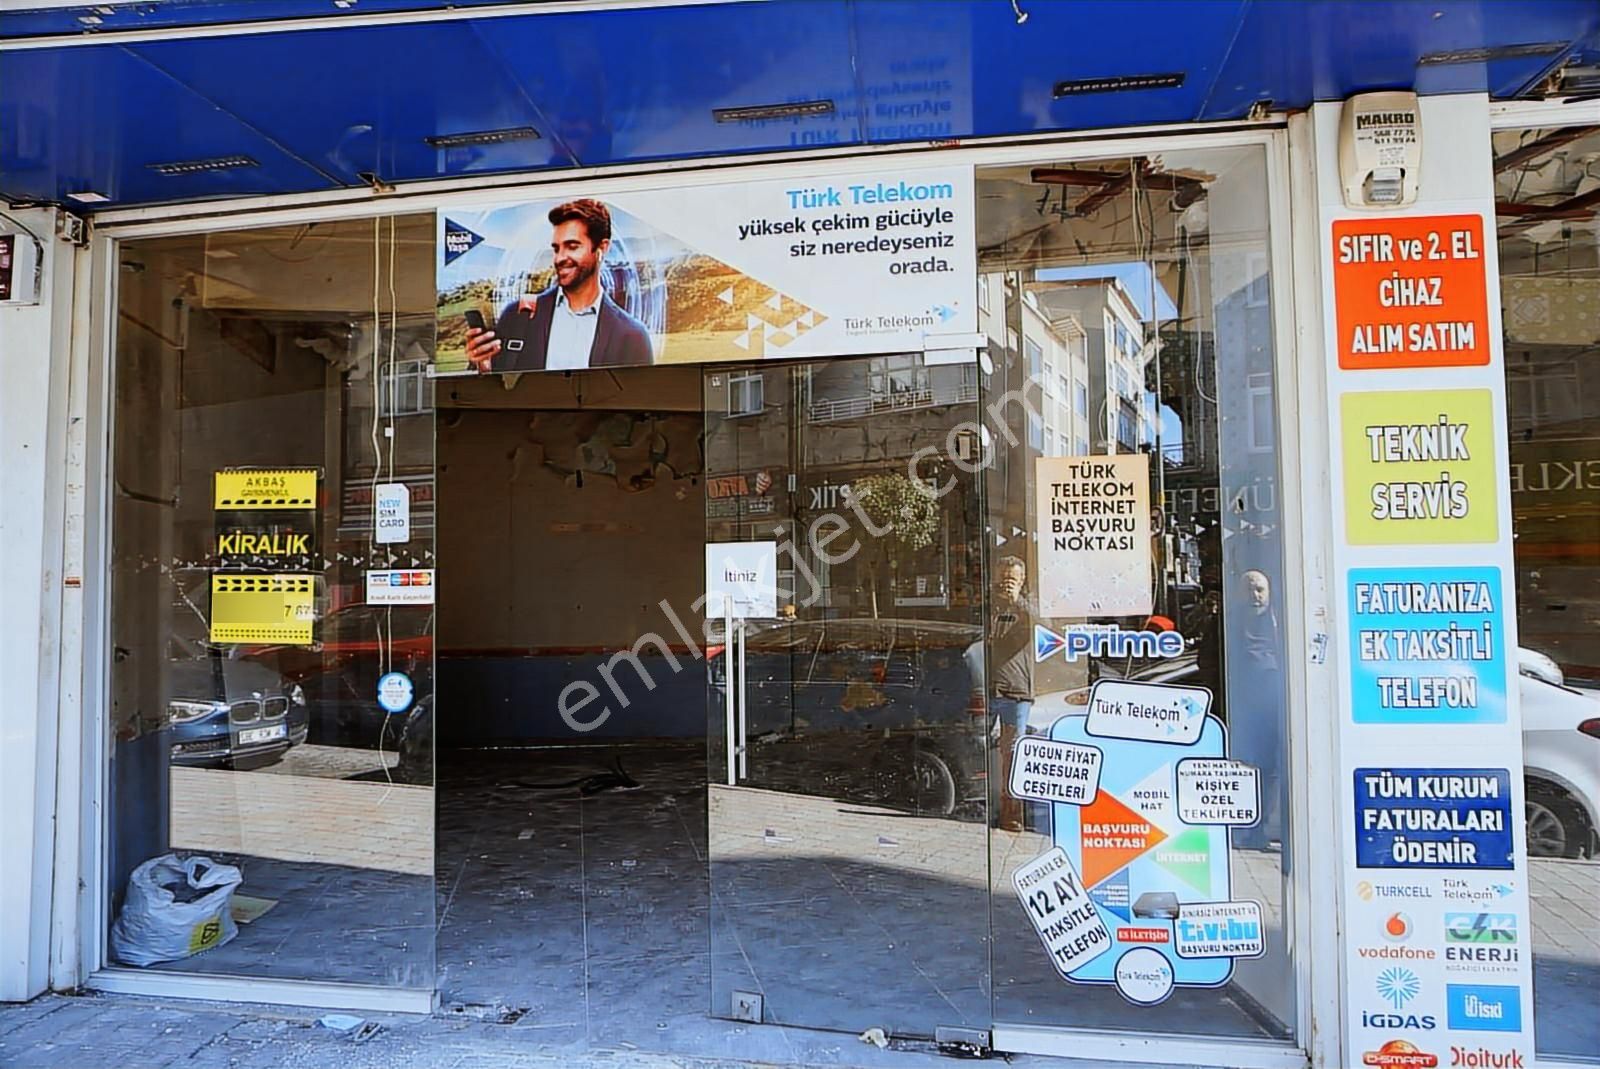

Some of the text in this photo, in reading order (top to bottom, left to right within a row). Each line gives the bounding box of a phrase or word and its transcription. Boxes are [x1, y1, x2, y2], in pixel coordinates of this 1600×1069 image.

[1356, 113, 1415, 130] MAKRO
[787, 181, 952, 209] Türk Telekom
[738, 207, 953, 240] yüksek çekim gücüyle
[790, 231, 954, 257] siz neredeyseniz
[1339, 231, 1479, 264] SIFIR ve 2. EL
[889, 257, 954, 275] orada.
[1379, 271, 1443, 308] CİHAZ
[844, 315, 934, 329] Türk Telekom
[1351, 322, 1475, 354] ALIM SATIM
[1365, 414, 1469, 462] TEKNİK
[1069, 461, 1116, 479] TÜRK
[246, 477, 286, 488] AKBAŞ
[1051, 481, 1134, 497] TELEKOM
[379, 499, 401, 508] NEW
[1371, 471, 1469, 519] SERVİS
[380, 509, 396, 518] SIM
[1051, 497, 1136, 515] İNTERNET
[379, 519, 405, 528] CARD
[1052, 517, 1136, 536] BAŞVURU
[218, 530, 309, 556] KİRALIK
[1054, 537, 1134, 551] NOKTASI
[724, 568, 757, 582] İtiniz
[1355, 582, 1494, 614] FATURANIZA
[1067, 629, 1183, 661] prime
[1360, 621, 1493, 661] EK TAKSİTLİ
[1377, 677, 1477, 709] TELEFON
[1095, 698, 1180, 722] Türk Telekom
[1024, 743, 1097, 766] UYGUN FİYAT
[1024, 761, 1089, 781] AKSESUAR
[1023, 780, 1086, 800] ÇEŞİTLERİ
[1133, 788, 1170, 800] MOBİL
[1195, 779, 1240, 791] KİŞİYE
[1365, 772, 1499, 799] TÜM KURUM
[1140, 801, 1163, 811] HAT
[1184, 807, 1253, 819] TEKLİFLER
[1083, 823, 1150, 836] BAŞVURU
[1364, 808, 1503, 832] FATURALARI
[1083, 837, 1146, 849] NOKTASI
[1393, 837, 1477, 864] ÖDENİR
[1053, 856, 1067, 869] EK
[1375, 886, 1432, 898] TURKCELL
[1443, 879, 1468, 888] Türk
[1029, 891, 1056, 918] 12
[1053, 872, 1079, 905] AY
[1444, 890, 1493, 900] Telekom
[1043, 903, 1096, 942] TAKSİTLE
[1178, 919, 1258, 941] tivibu
[1055, 925, 1107, 963] TELEFON
[1181, 944, 1260, 954] BAŞVURU NOKTASI
[1358, 946, 1435, 960] vodafone
